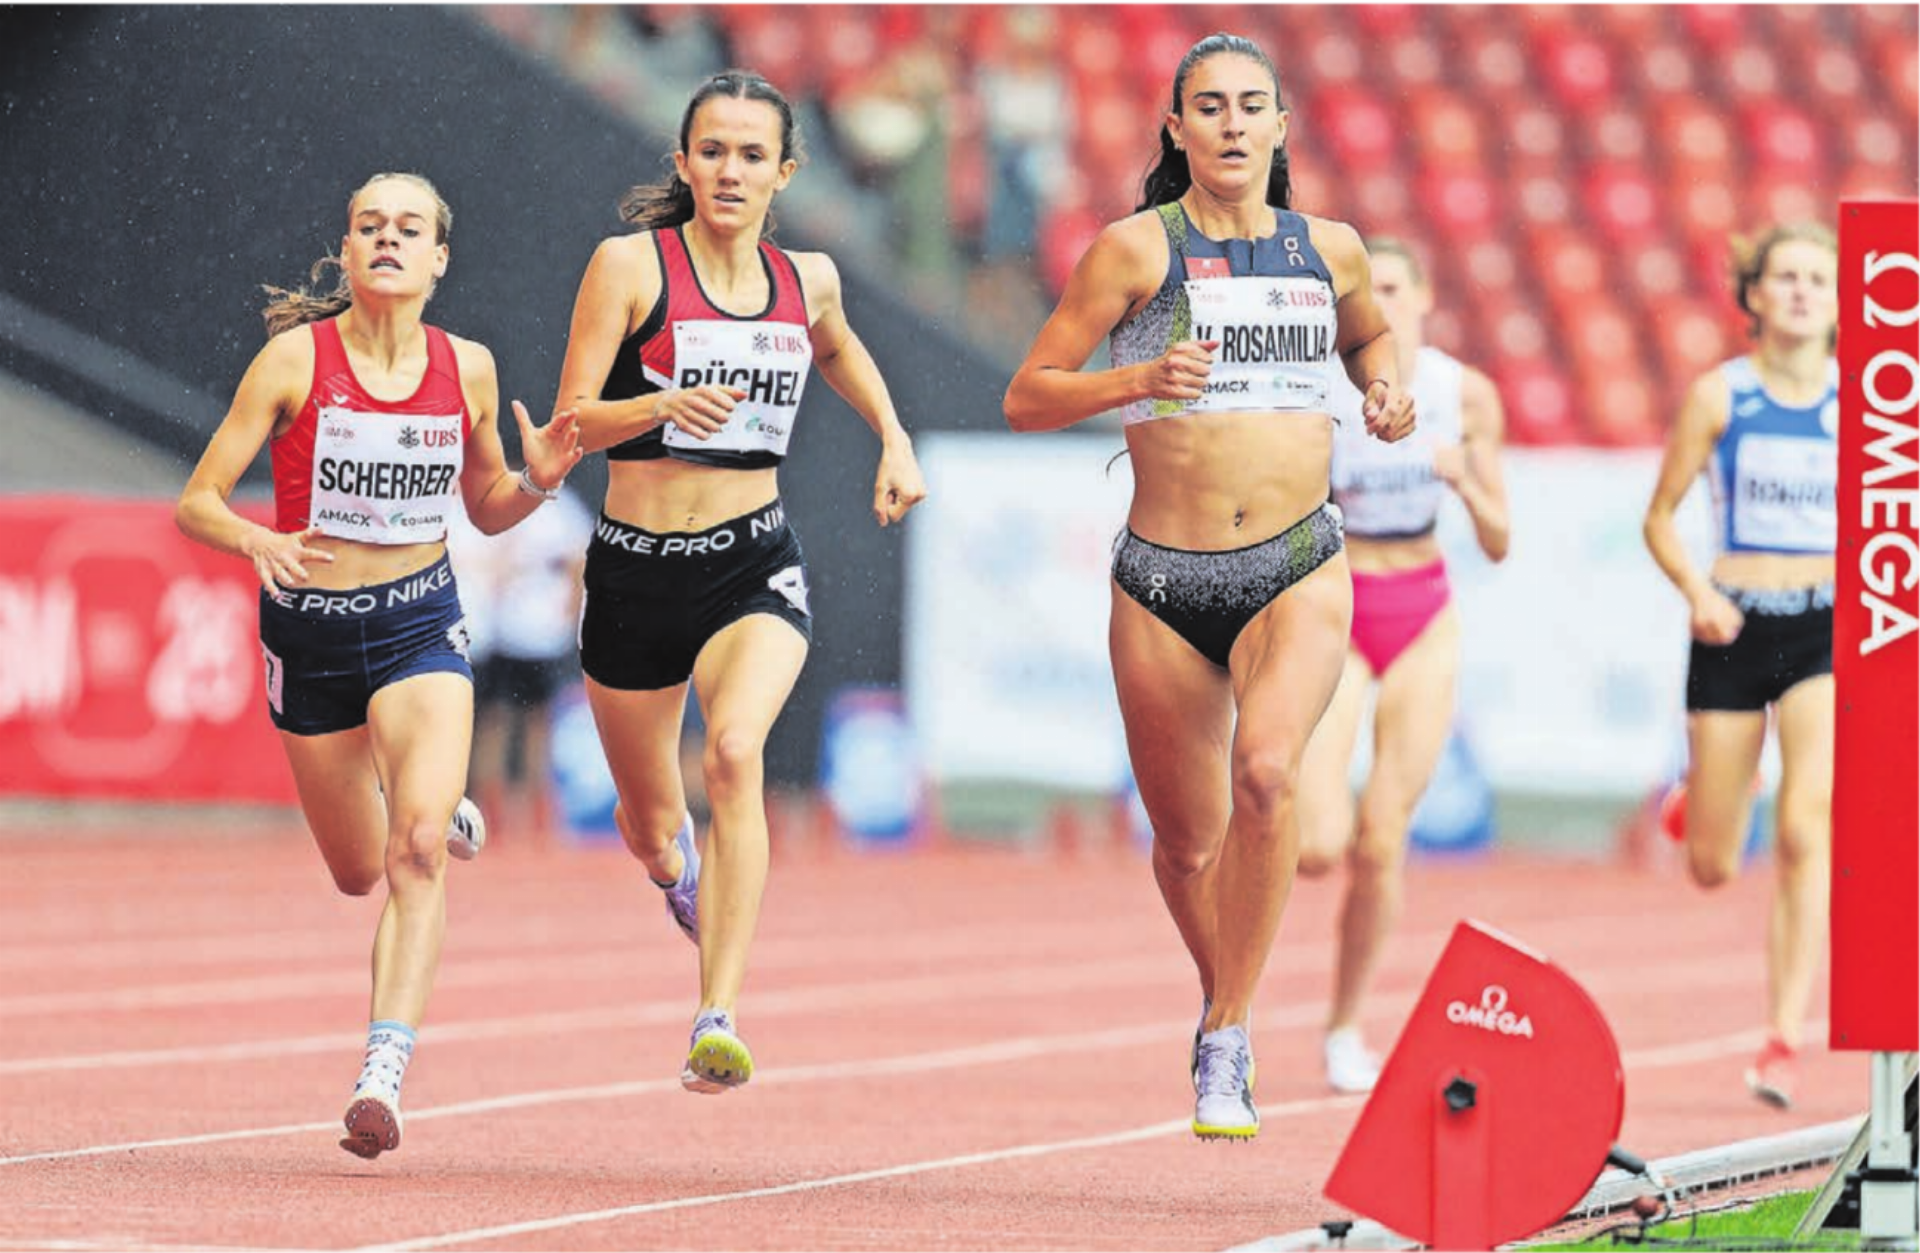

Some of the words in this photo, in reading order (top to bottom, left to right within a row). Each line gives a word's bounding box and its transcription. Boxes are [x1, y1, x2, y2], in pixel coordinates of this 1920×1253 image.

[1288, 289, 1328, 307] UBS
[773, 334, 806, 354] UBS
[1221, 323, 1328, 363] ROSAMILIA
[422, 427, 459, 448] UBS
[318, 456, 457, 500] SCHERRER
[317, 508, 372, 527] AMACX
[1858, 349, 1920, 657] OMEGA
[659, 529, 736, 557] PRO
[299, 593, 377, 615] PRO
[385, 561, 453, 608] NIKE
[1446, 1000, 1535, 1040] OMEGA
